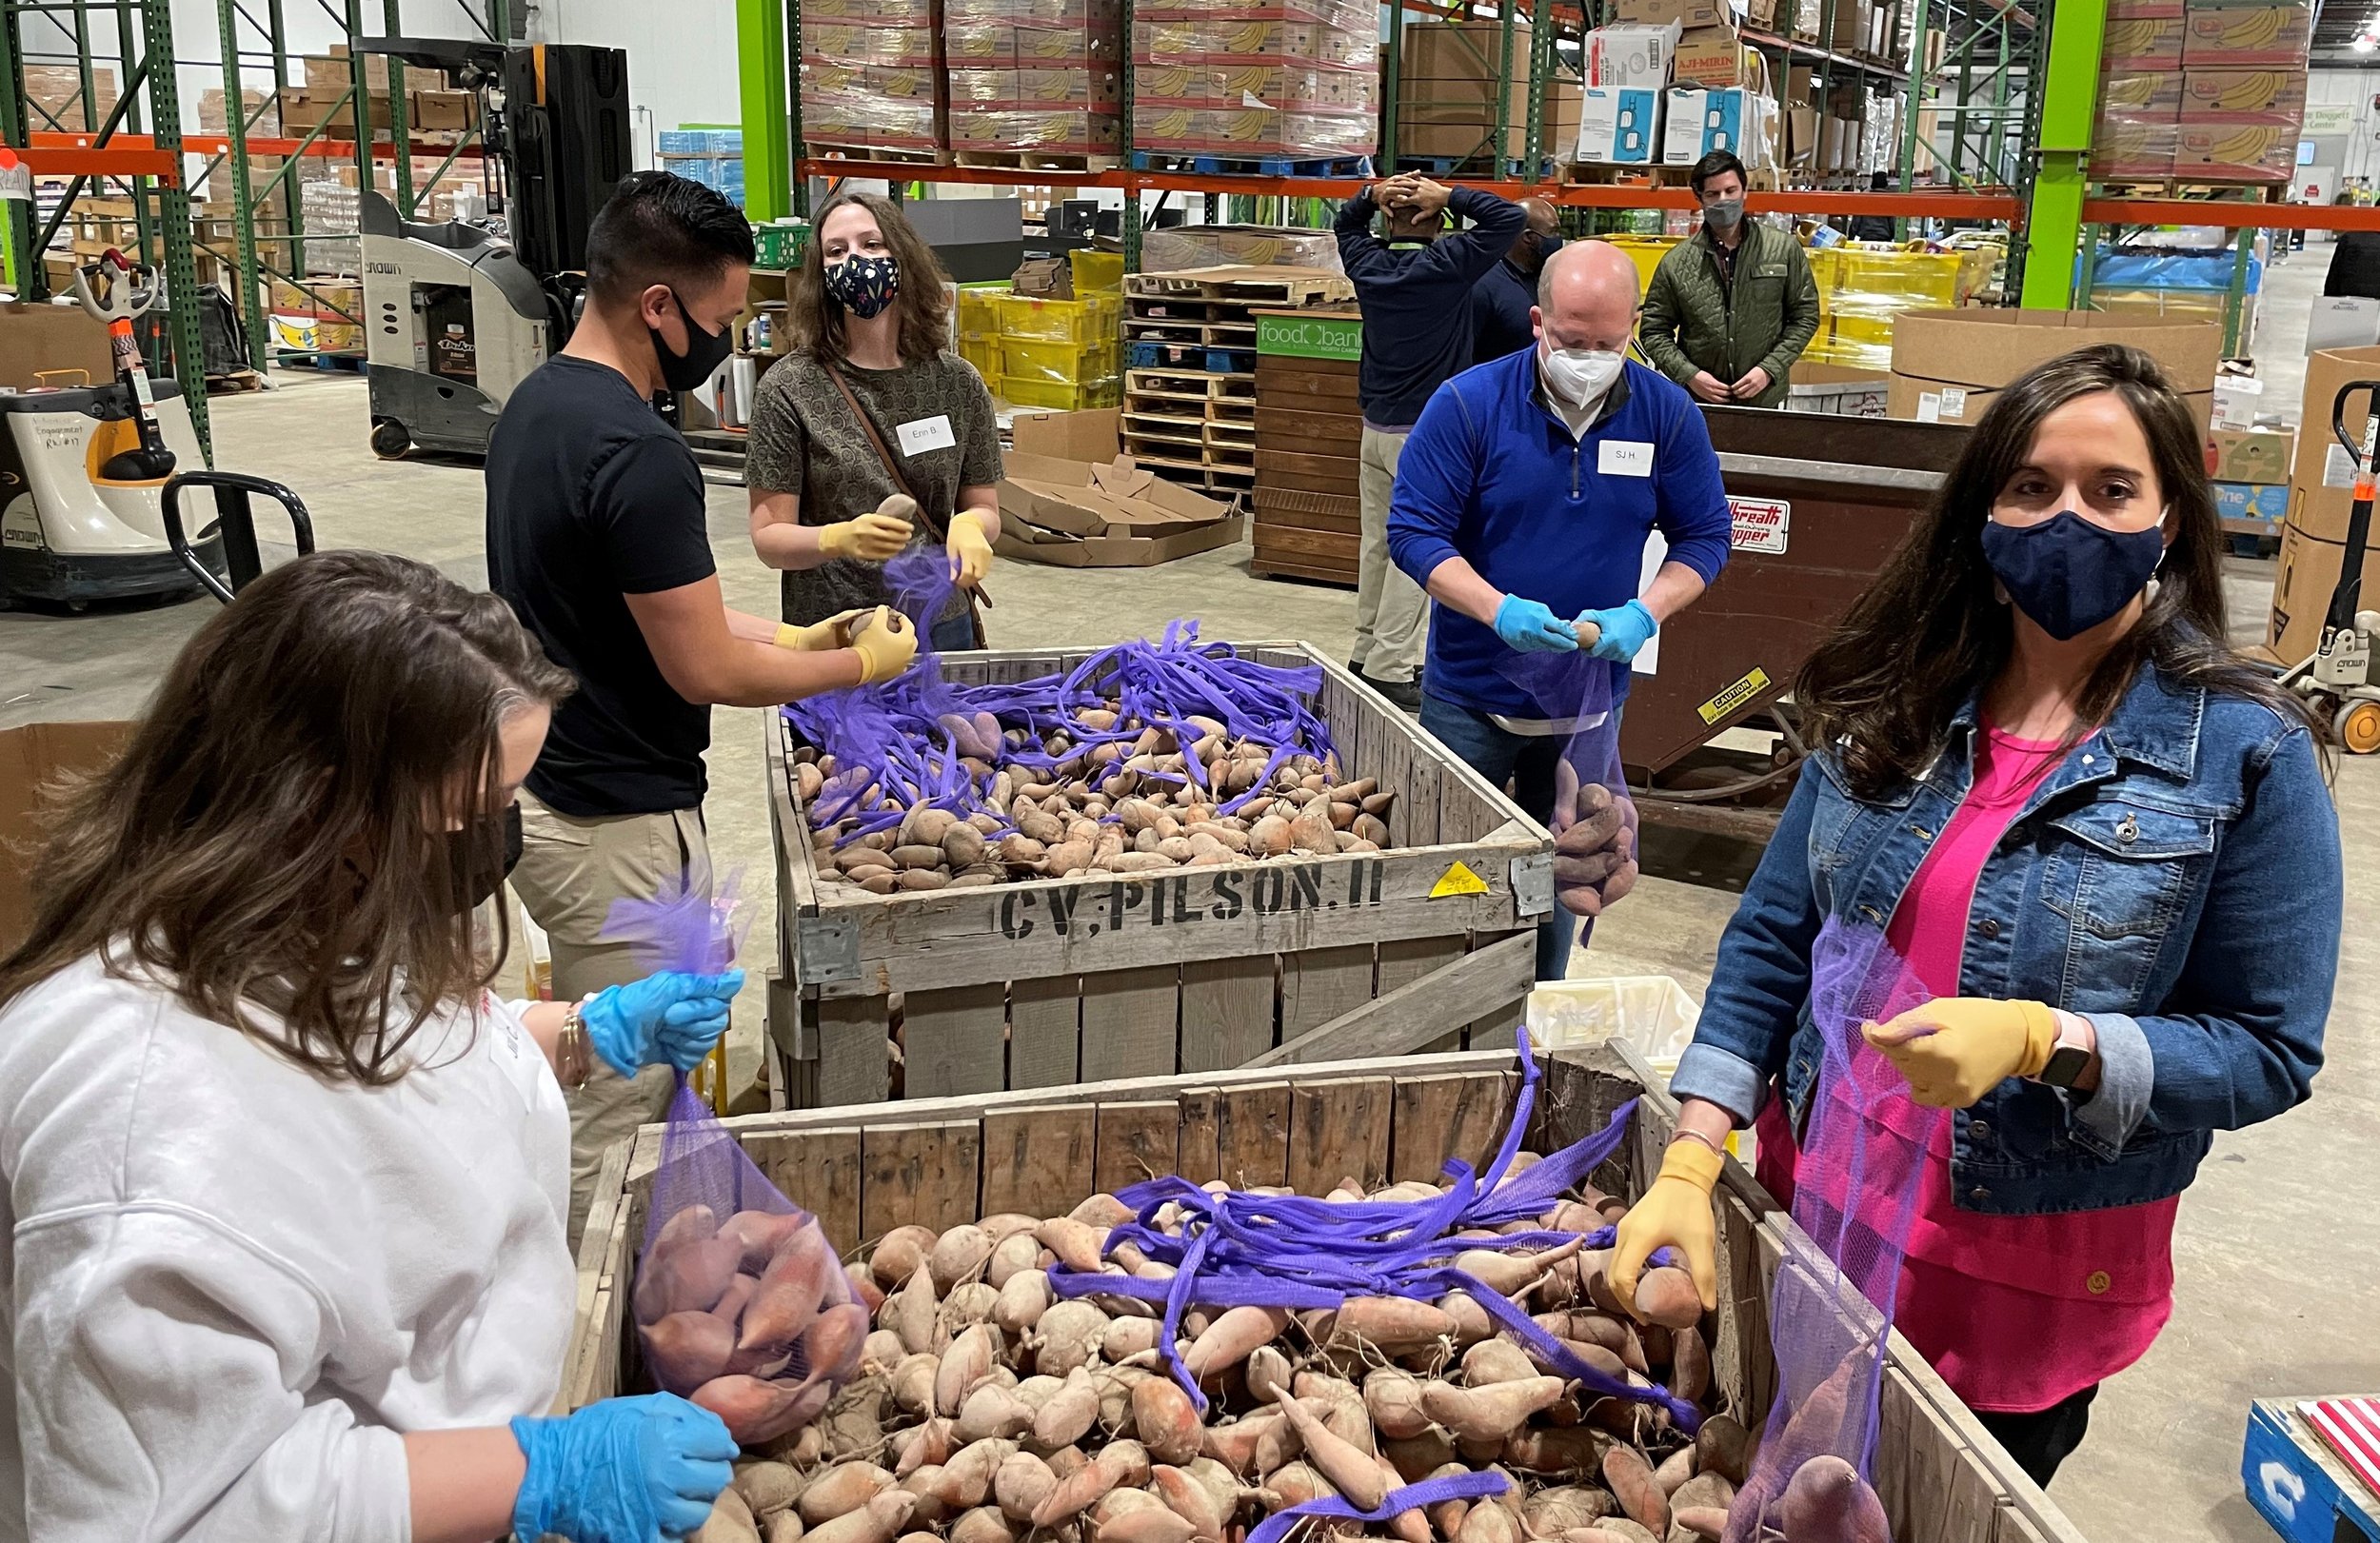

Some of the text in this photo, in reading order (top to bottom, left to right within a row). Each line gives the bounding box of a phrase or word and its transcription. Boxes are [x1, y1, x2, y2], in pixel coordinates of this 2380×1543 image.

[1677, 56, 1735, 69] AJI-MIRIN
[2315, 110, 2350, 121] Doggett
[1260, 321, 1304, 344] food
[912, 429, 929, 439] Erin
[1616, 450, 1627, 459] SJ
[1715, 680, 1751, 708] CAUTION
